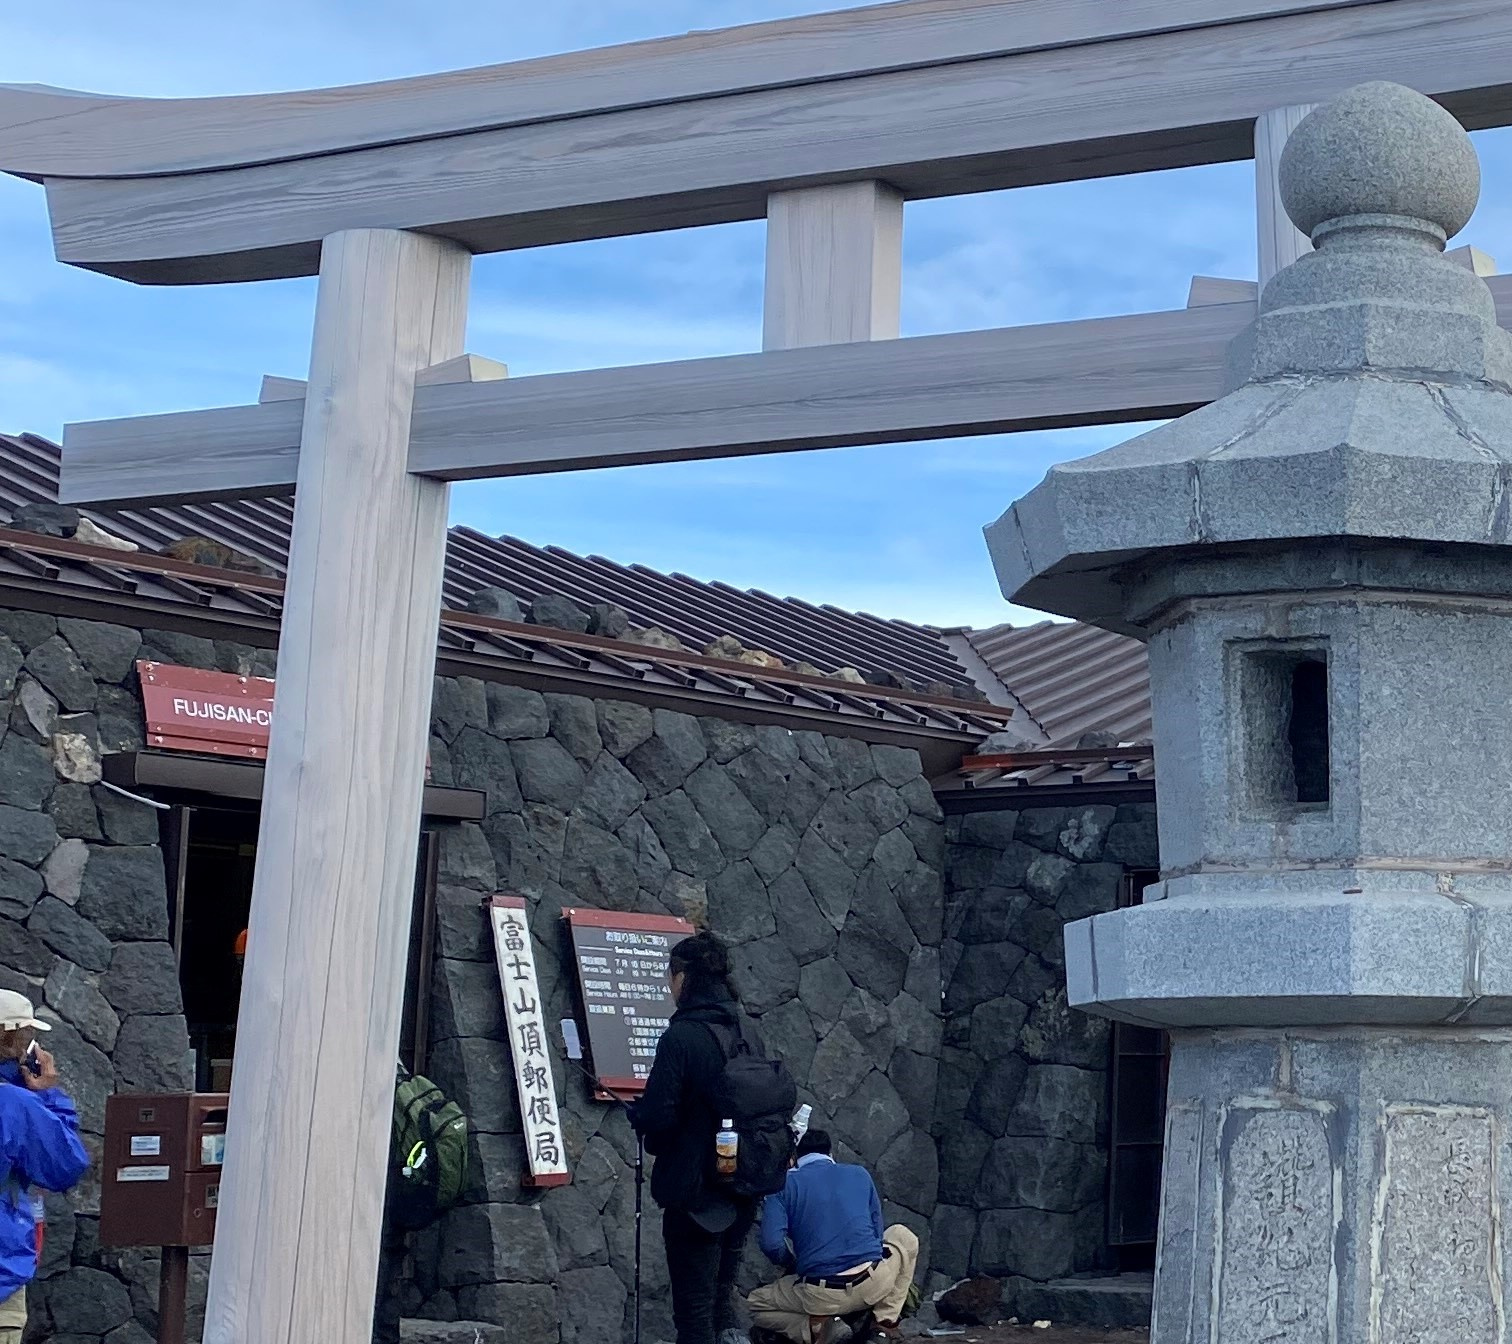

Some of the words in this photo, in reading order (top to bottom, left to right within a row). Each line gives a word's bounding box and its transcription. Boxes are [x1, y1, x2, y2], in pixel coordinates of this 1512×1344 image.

[173, 698, 272, 726] FUJISAN-C
[500, 915, 560, 1167] 富士山頂郵便局
